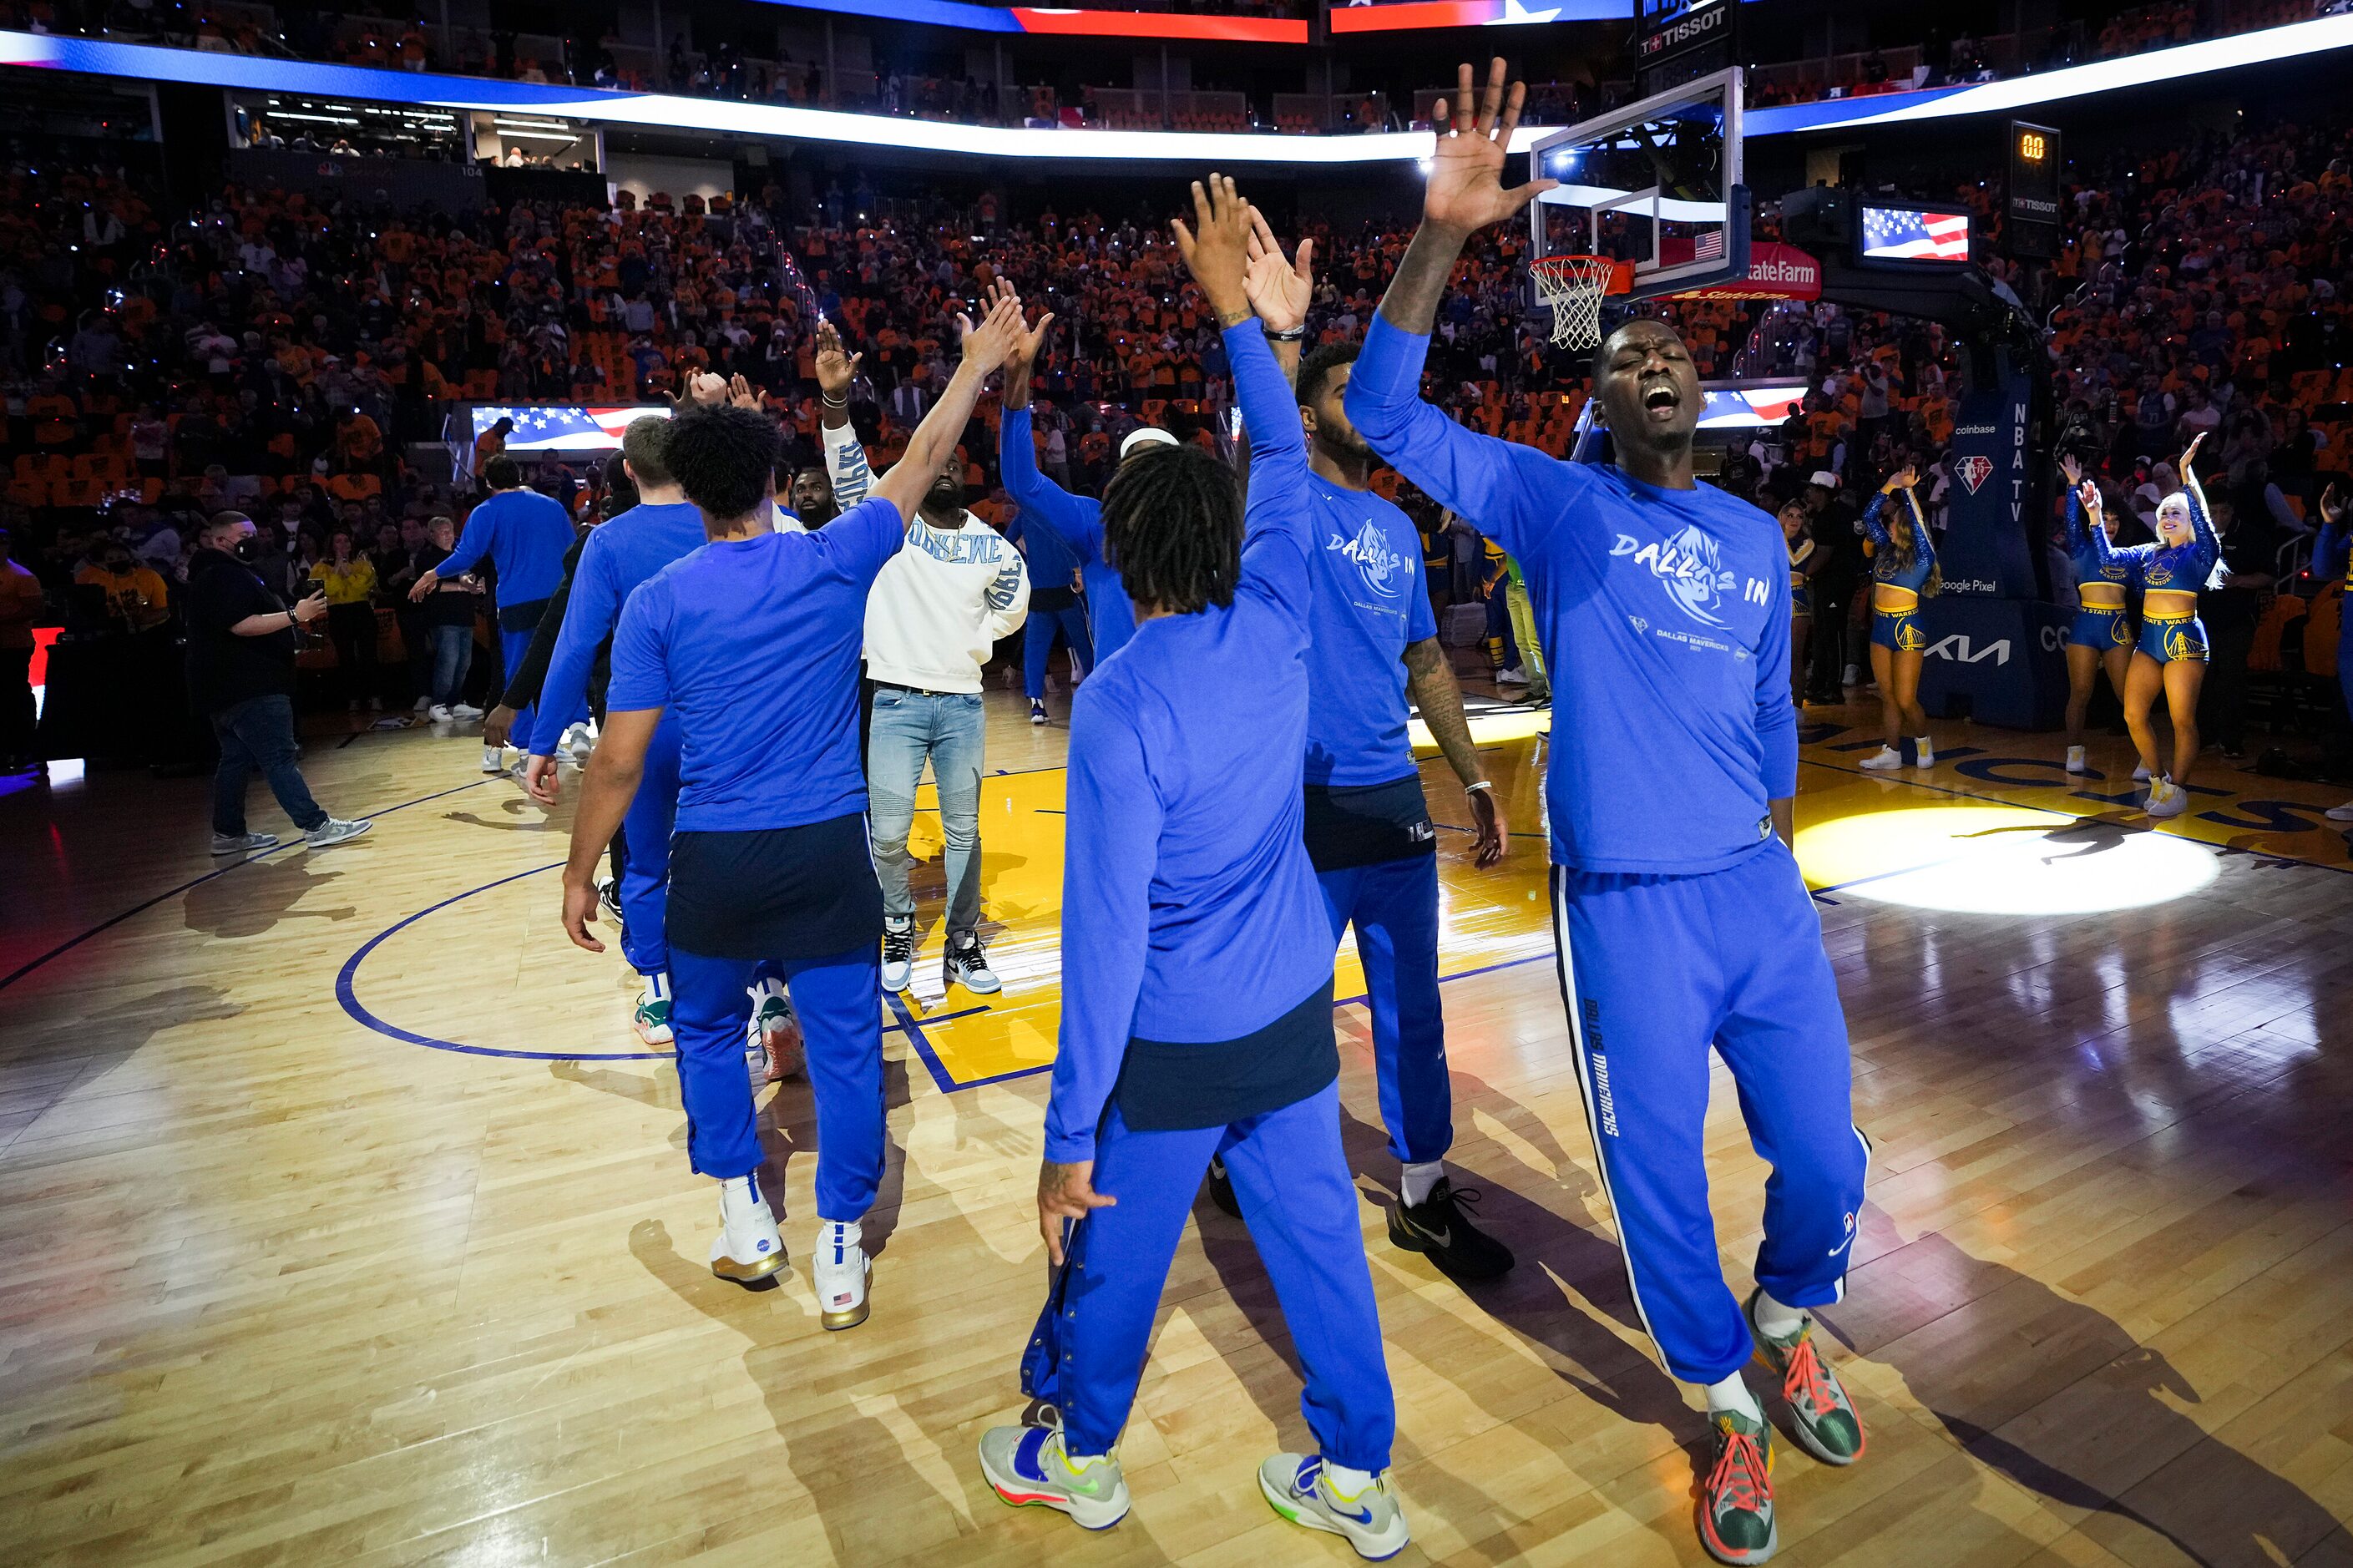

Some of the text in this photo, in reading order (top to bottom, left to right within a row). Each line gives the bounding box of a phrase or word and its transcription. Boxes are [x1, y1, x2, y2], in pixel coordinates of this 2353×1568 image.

[1662, 6, 1726, 46] TISSOT
[461, 166, 483, 177] 104
[2025, 199, 2057, 213] TISSOT
[1748, 260, 1814, 283] tateFarm
[1955, 425, 1996, 435] coinbase
[2011, 402, 2026, 522] NBA TV
[1326, 533, 1414, 575] DALLAS IN
[1609, 533, 1771, 608] DALLAS IN
[1972, 579, 1996, 593] Pixel
[2144, 574, 2173, 586] WARRIORS
[1354, 601, 1373, 610] DALLAS
[2088, 608, 2113, 616] STATE
[1656, 629, 1688, 642] DALLAS
[1688, 637, 1730, 652] MAVERICKS
[1591, 1052, 1620, 1138] MAVERICKS
